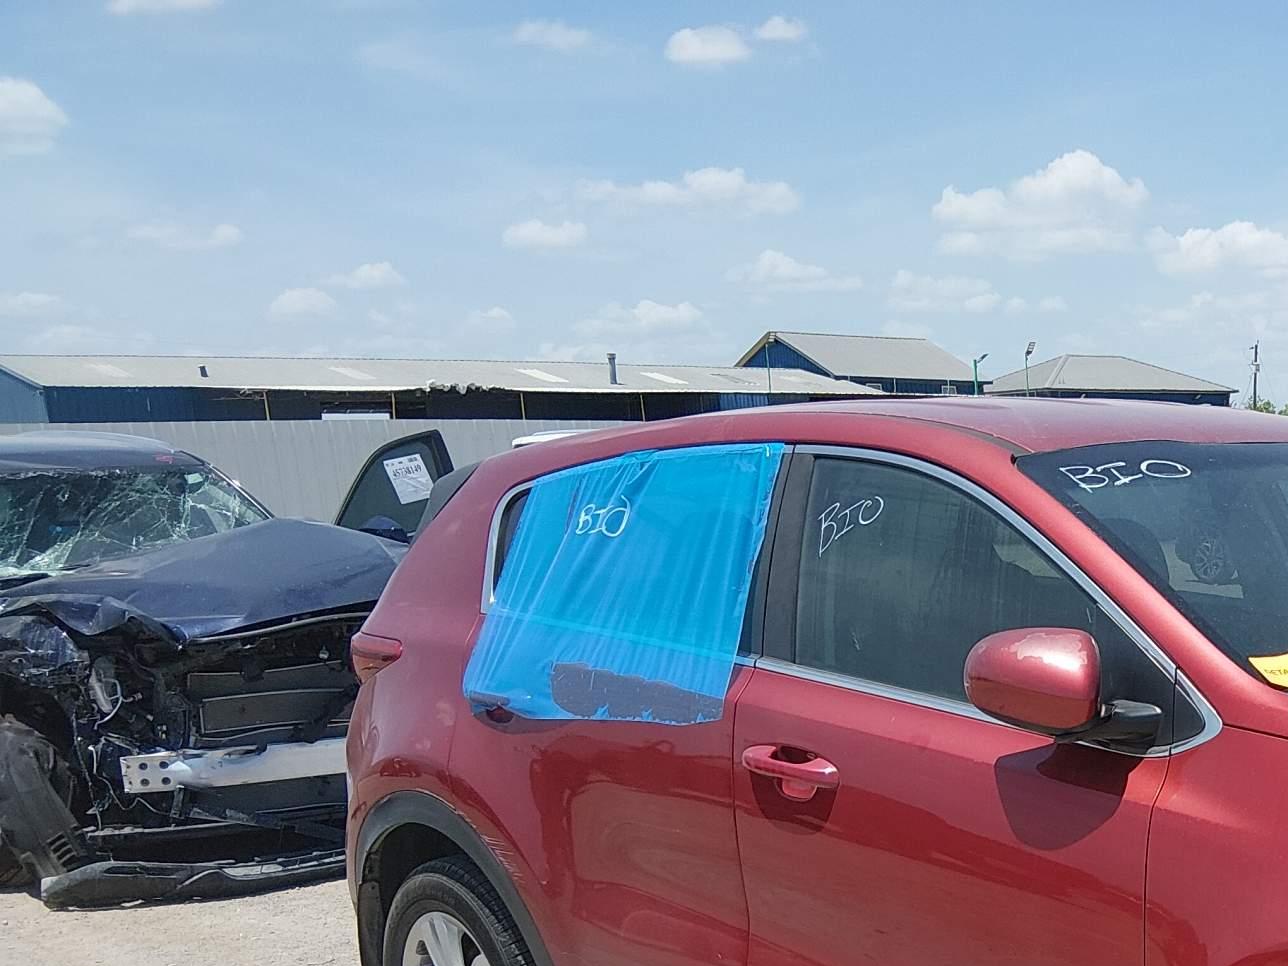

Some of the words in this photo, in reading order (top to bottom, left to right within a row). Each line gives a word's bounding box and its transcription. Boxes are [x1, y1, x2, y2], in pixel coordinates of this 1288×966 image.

[1059, 459, 1191, 493] BIO
[575, 494, 631, 537] BIO
[818, 496, 884, 558] BIO
